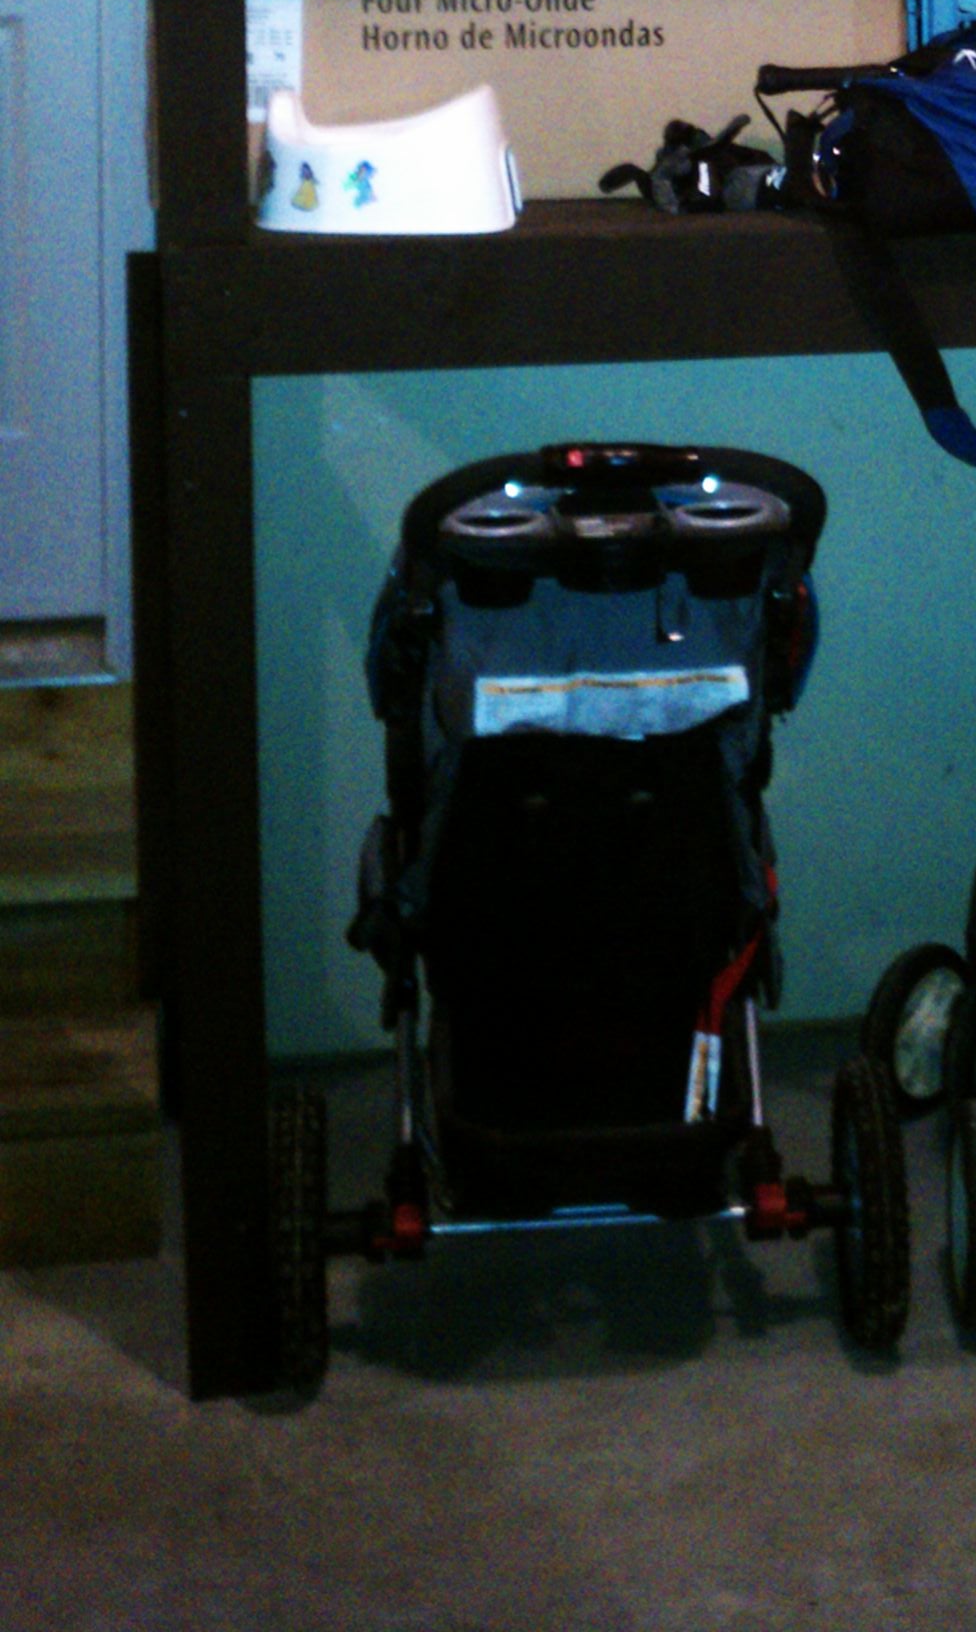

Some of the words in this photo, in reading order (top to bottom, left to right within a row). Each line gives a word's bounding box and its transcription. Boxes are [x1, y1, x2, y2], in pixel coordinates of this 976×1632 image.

[362, 23, 448, 51] Horno
[460, 22, 493, 50] de
[504, 20, 665, 49] Microondas
